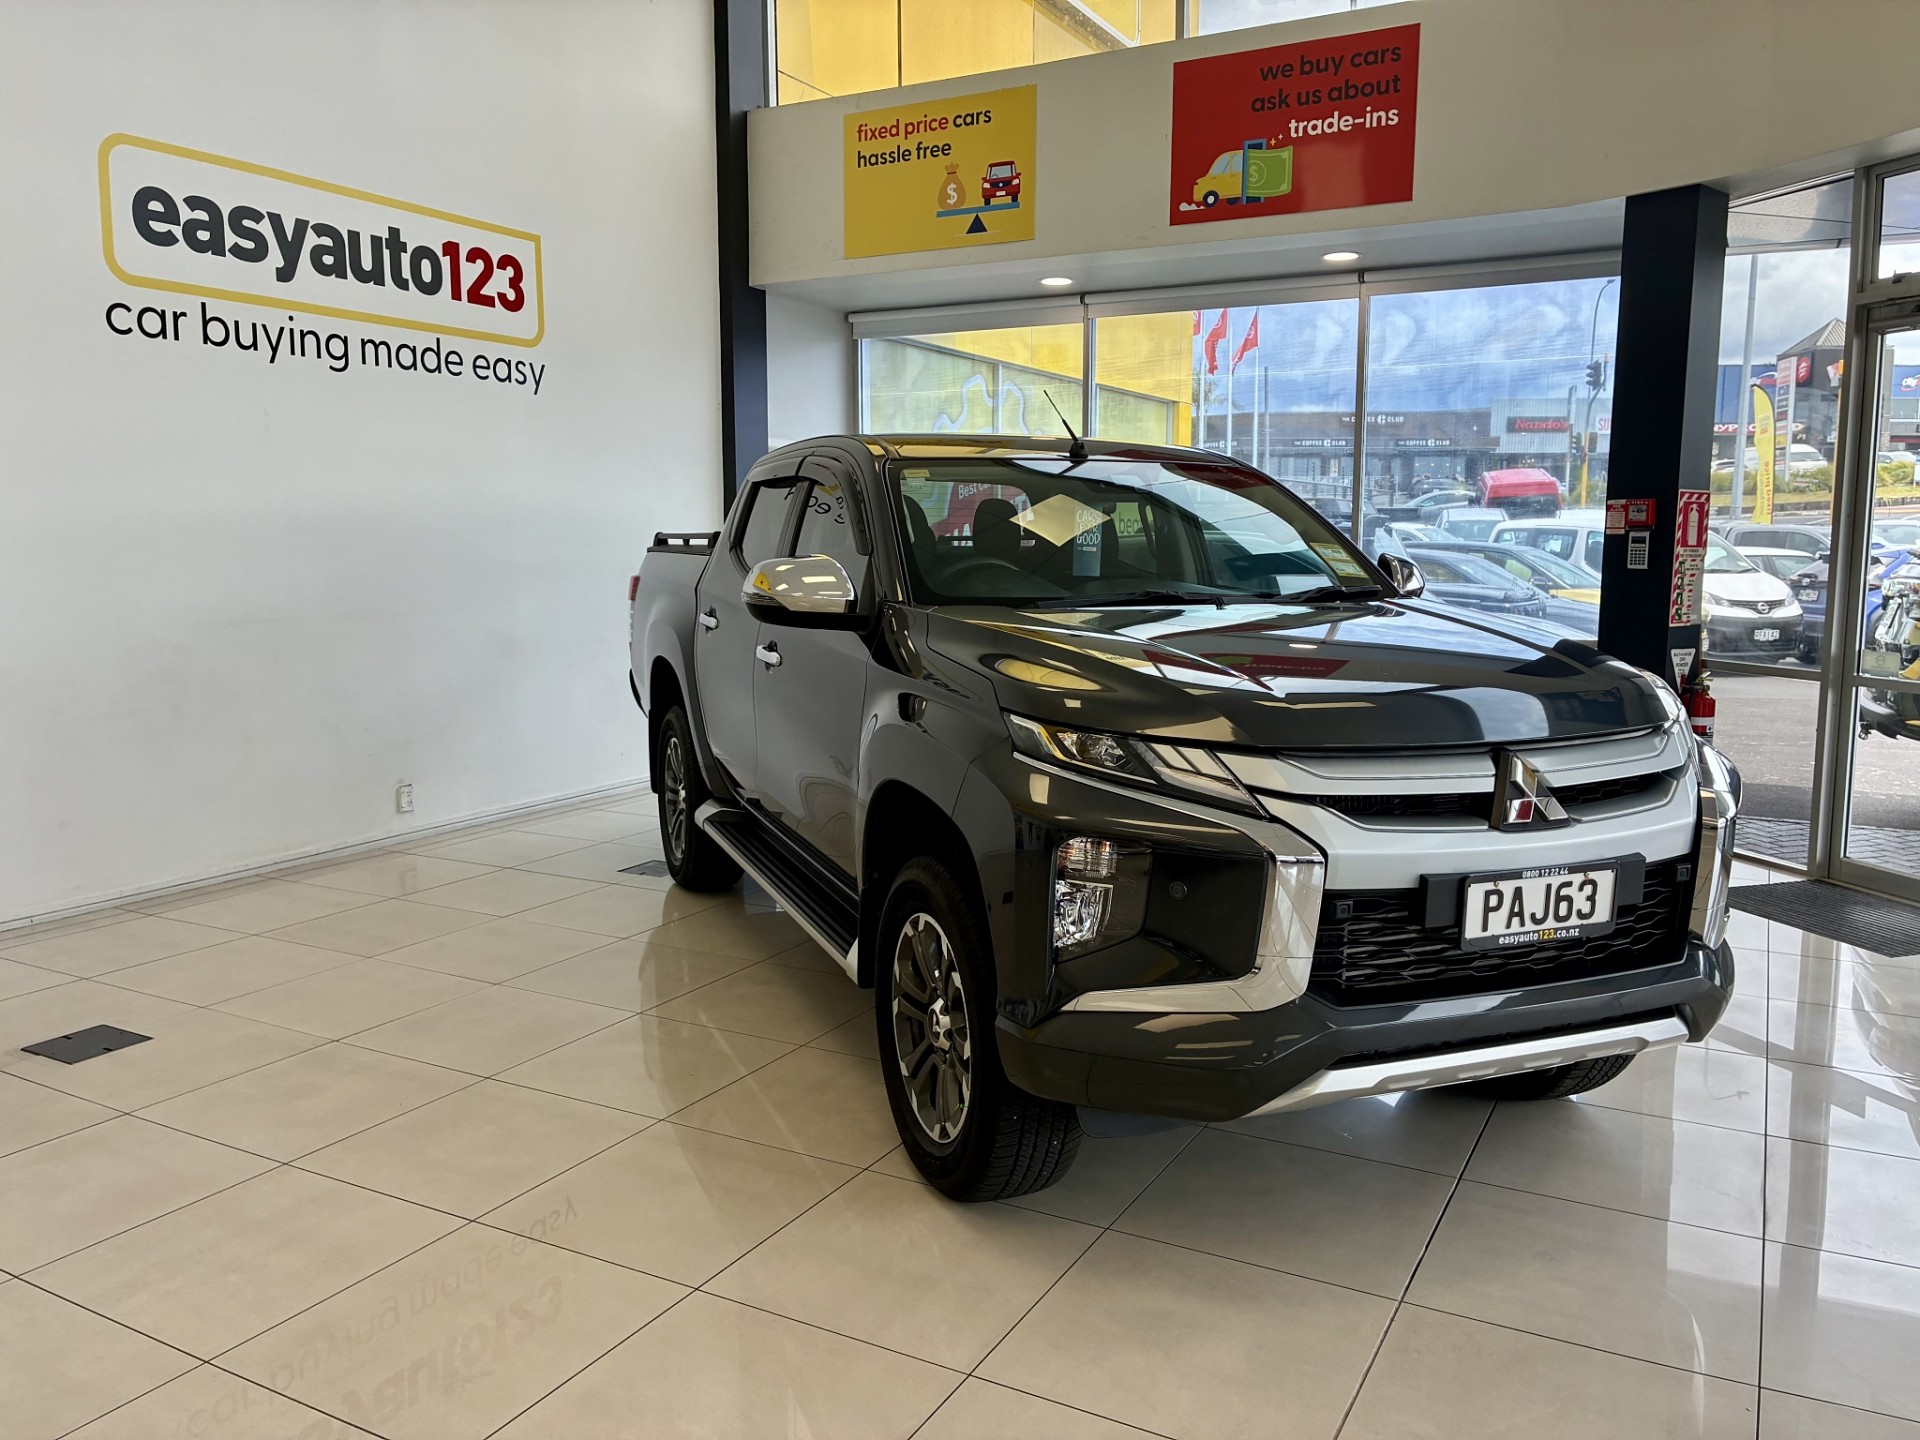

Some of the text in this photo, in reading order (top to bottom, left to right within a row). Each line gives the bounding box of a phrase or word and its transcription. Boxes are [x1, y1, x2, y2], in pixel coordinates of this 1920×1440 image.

[1260, 46, 1402, 81] we buy cars
[1251, 74, 1401, 113] ask us about
[857, 109, 992, 142] fixed price cars
[1289, 106, 1399, 138] trade-ins
[857, 141, 952, 168] hassle free
[131, 185, 526, 313] easyauto123
[105, 302, 546, 396] car buying made easy
[1514, 418, 1568, 431] Nando's
[958, 483, 977, 500] Best
[1076, 532, 1100, 545] GOOD
[1522, 867, 1569, 878] 0800 12 22 44
[1481, 878, 1599, 933] PAJ63
[1498, 927, 1580, 945] easyauto123.co.nz
